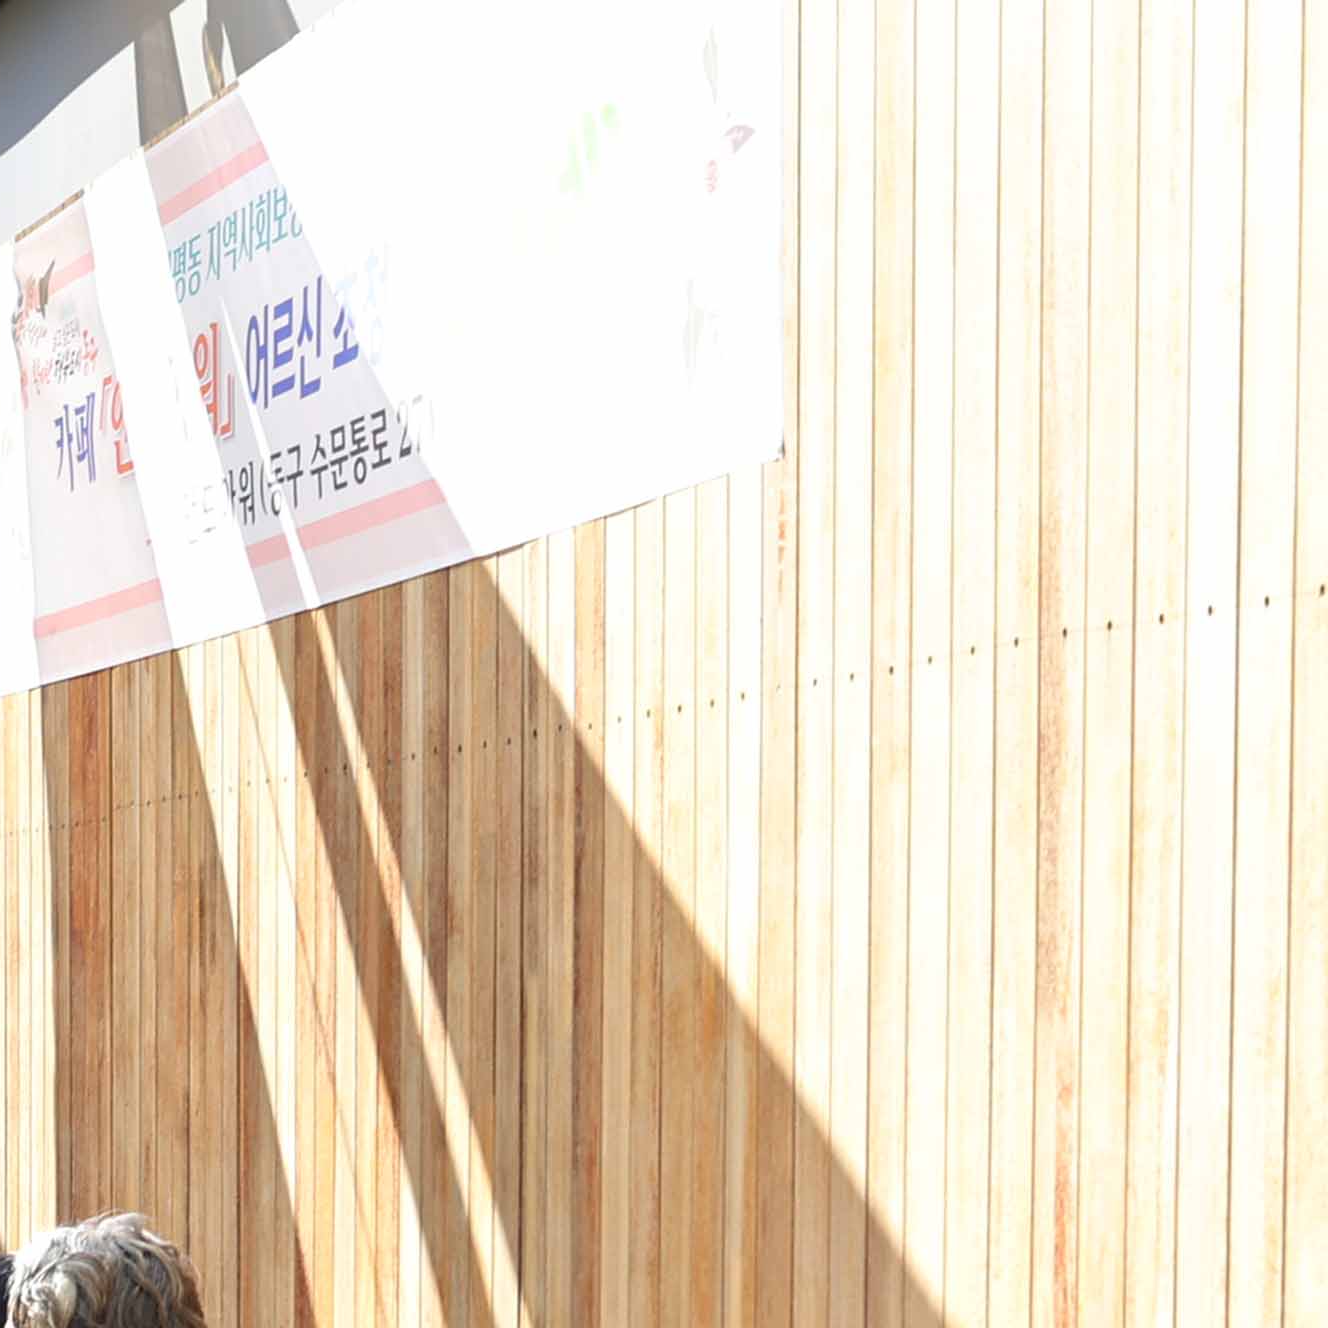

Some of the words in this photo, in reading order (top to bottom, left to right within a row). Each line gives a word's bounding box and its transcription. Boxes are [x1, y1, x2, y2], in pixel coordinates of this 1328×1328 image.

[168, 234, 202, 303] 평동
[54, 392, 96, 492] 카페
[246, 275, 322, 410] 어르신
[310, 408, 392, 499] 수문통로
